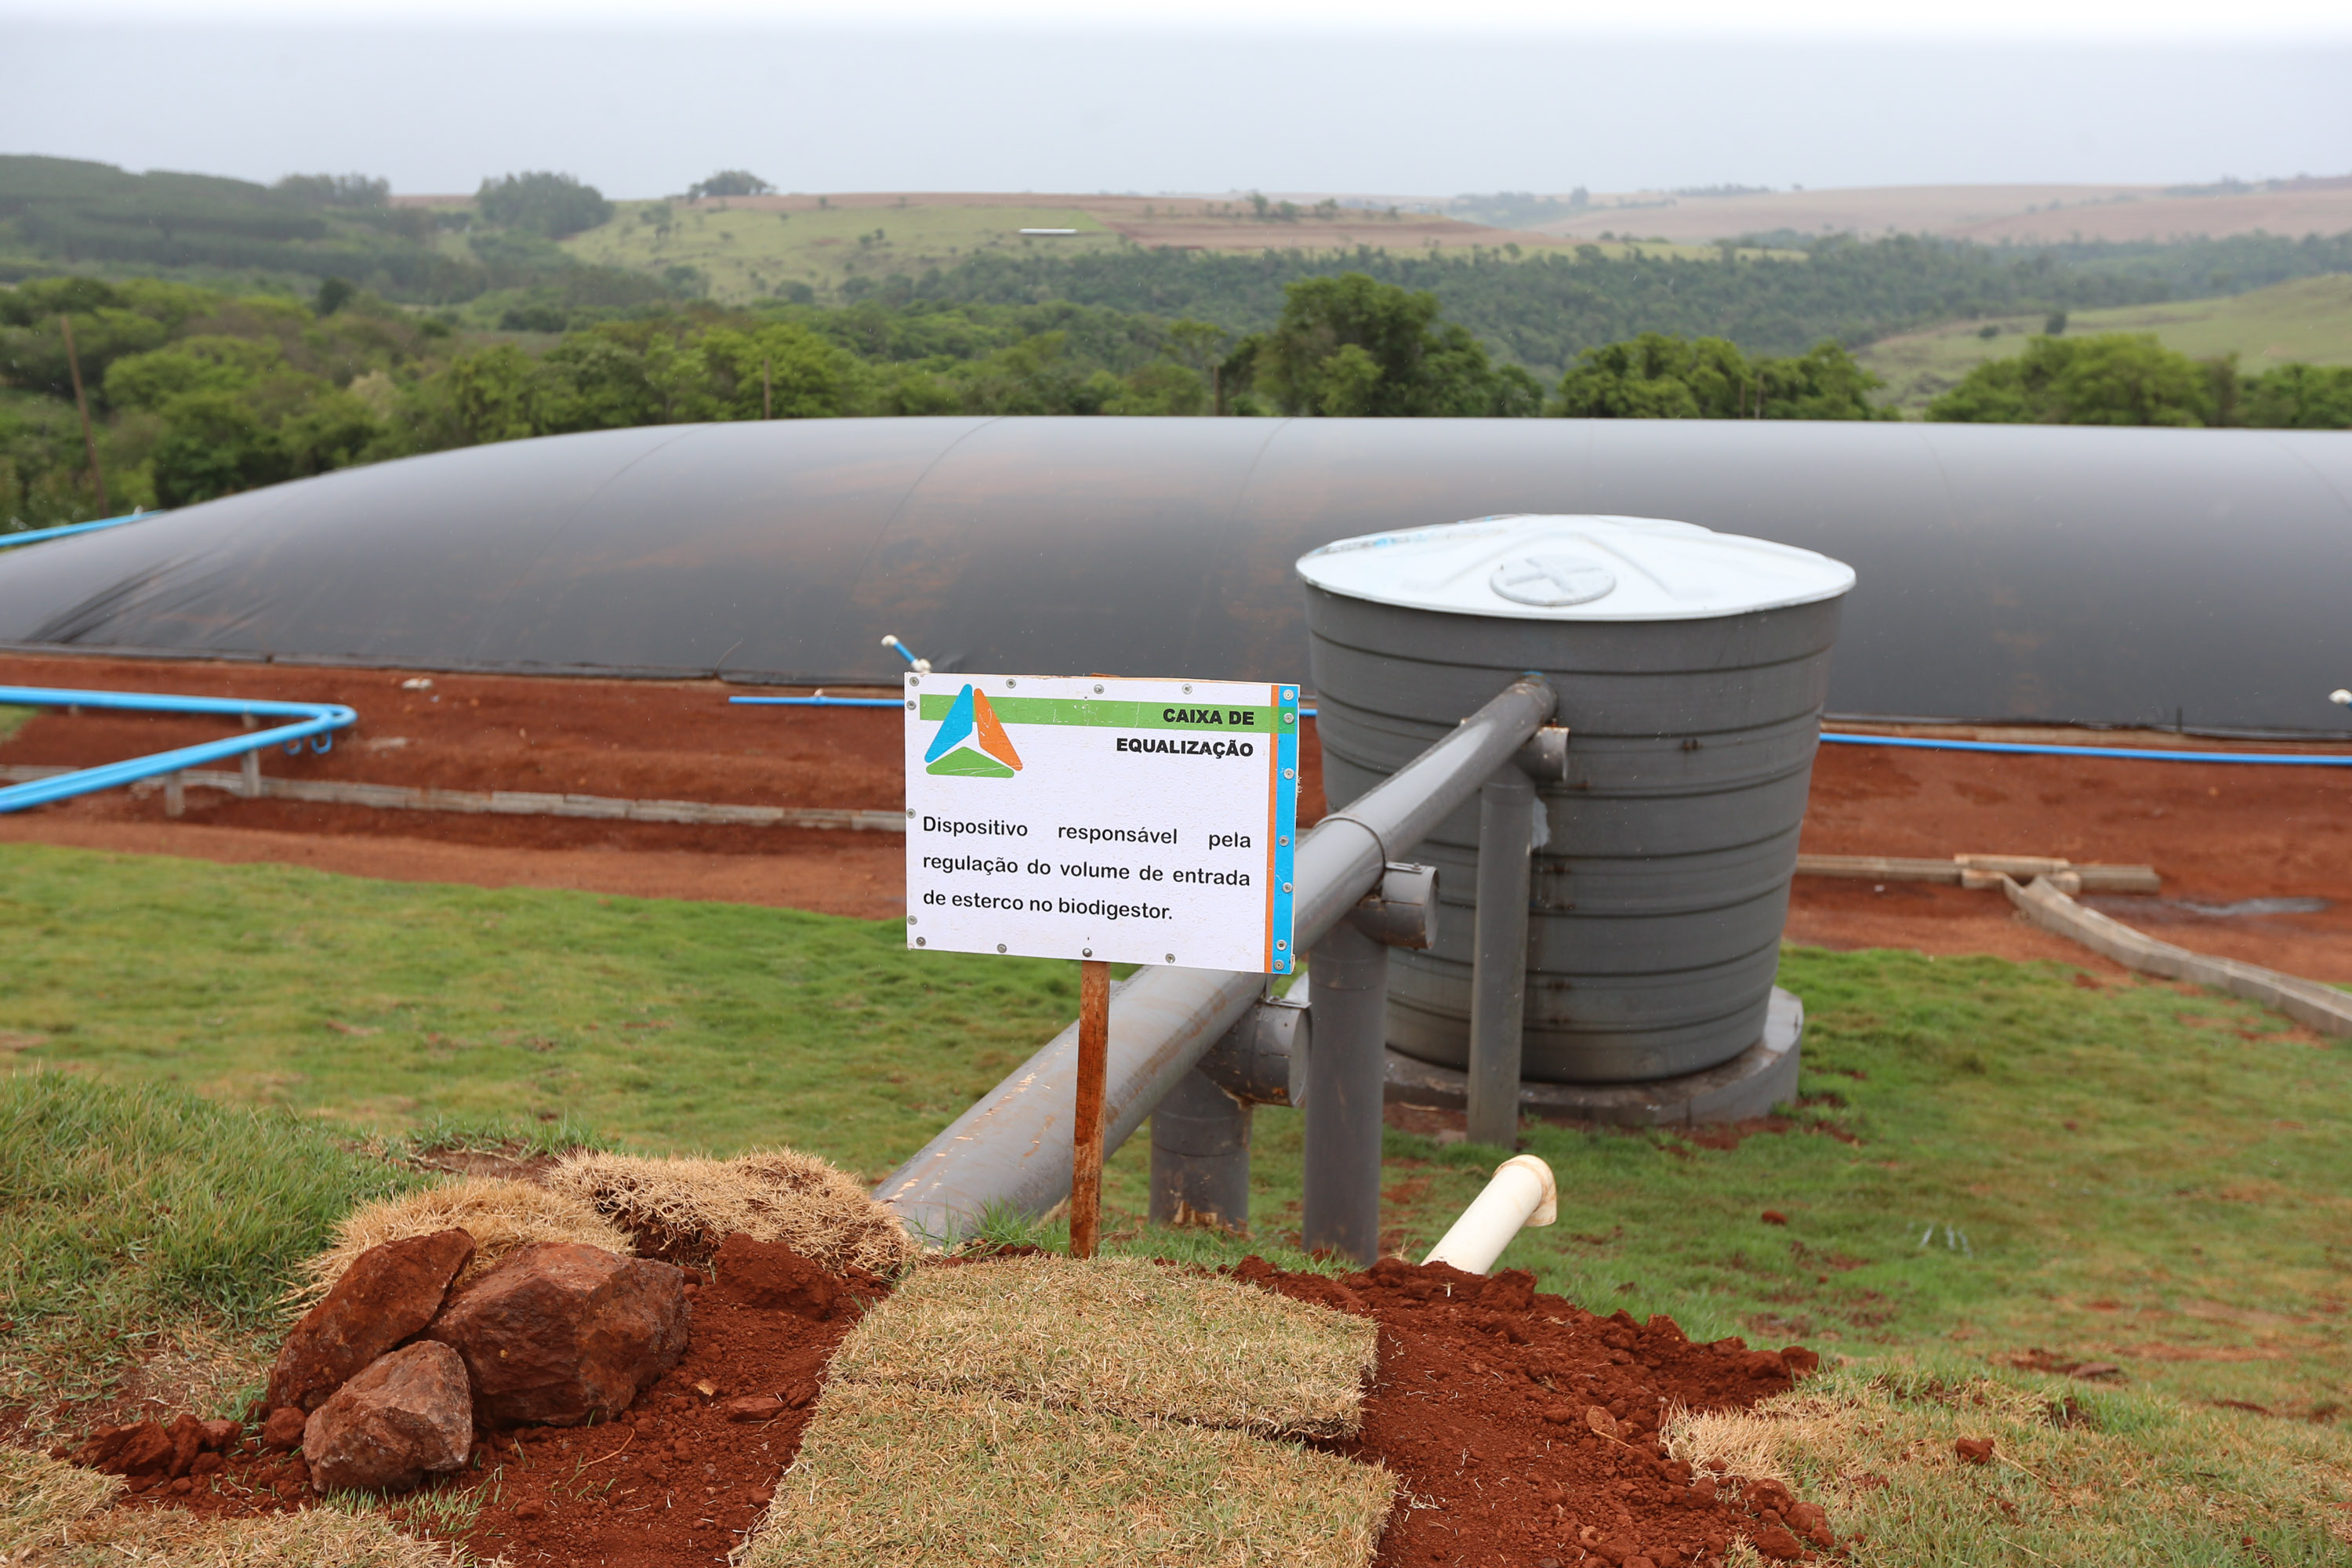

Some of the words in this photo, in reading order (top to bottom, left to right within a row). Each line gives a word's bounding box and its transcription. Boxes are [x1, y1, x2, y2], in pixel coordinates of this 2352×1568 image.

[1163, 708, 1223, 724] CAIXA
[1229, 710, 1254, 726] DE
[1116, 738, 1254, 759] EQUALIZAÇÃO
[924, 816, 1028, 837] Dispositivo
[1058, 826, 1178, 844] responsável
[1209, 832, 1251, 851] pela
[924, 855, 1018, 876] regulação
[1027, 858, 1051, 875] do
[1060, 861, 1130, 880] volume
[1139, 865, 1163, 881] de
[1173, 868, 1250, 886] entrada
[924, 890, 946, 906] de
[952, 892, 1024, 910] esterco
[1029, 899, 1053, 912] no
[1059, 897, 1174, 920] biodigestor.
